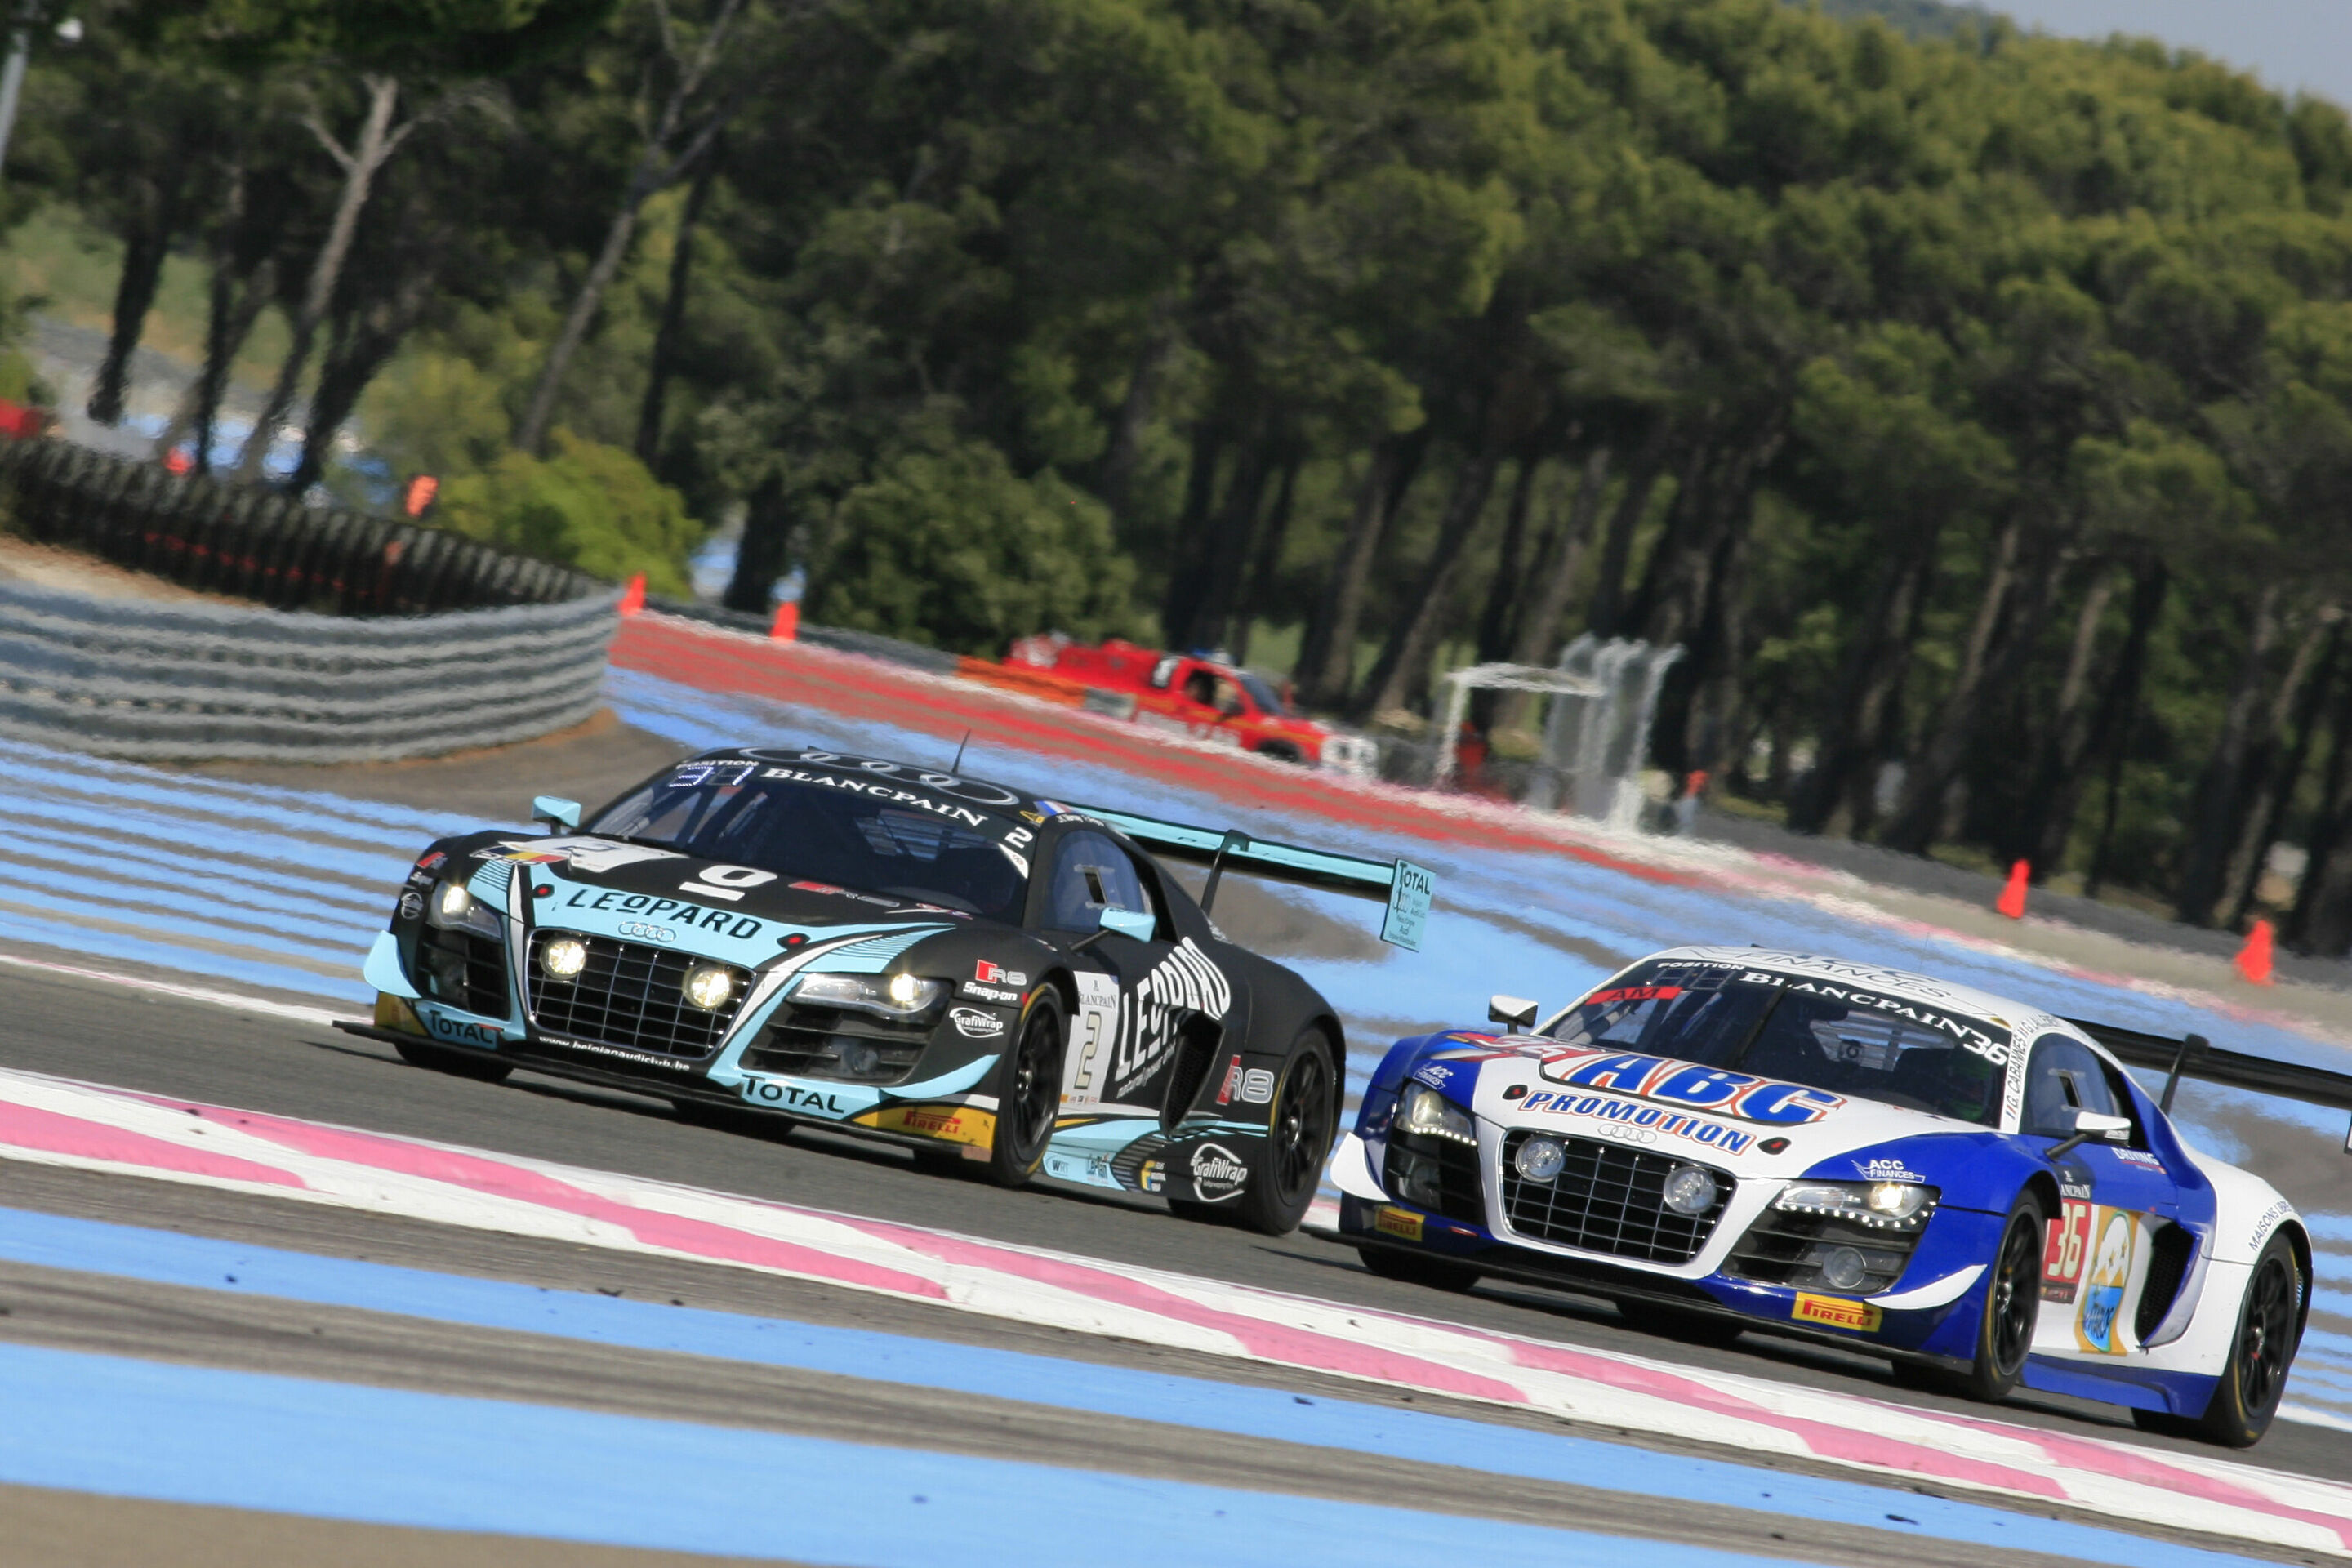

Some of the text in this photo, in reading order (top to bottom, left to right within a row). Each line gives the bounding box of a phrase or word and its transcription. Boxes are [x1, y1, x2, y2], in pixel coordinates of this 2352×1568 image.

[760, 768, 988, 826] BLANCPAIN
[1004, 826, 1033, 849] 2
[1400, 862, 1430, 895] TOTAL
[566, 889, 762, 939] LEOPARD
[987, 967, 1027, 987] R8
[1657, 962, 1745, 971] POSITION
[1735, 952, 1953, 998] FINANCES
[963, 982, 1018, 1000] Snap-on
[1607, 987, 1659, 1002] AM
[1739, 971, 1971, 1038] BLANCPAIN
[430, 1009, 492, 1044] TOTAL
[954, 1013, 1004, 1031] GrafiWrap
[1074, 1011, 1102, 1089] 2
[1962, 1027, 2011, 1066] 36
[742, 1066, 844, 1113] TOTAL
[1222, 1065, 1275, 1104] R8
[1561, 1053, 1846, 1125] ABC
[902, 1110, 963, 1134] PIRELLI
[1520, 1091, 1756, 1155] PROMOTION
[1192, 1156, 1248, 1186] GrafiWrap
[1869, 1160, 1904, 1170] ACC
[1869, 1169, 1915, 1179] FINANCES
[2047, 1202, 2087, 1279] 36
[1802, 1299, 1873, 1326] PIRELLI
